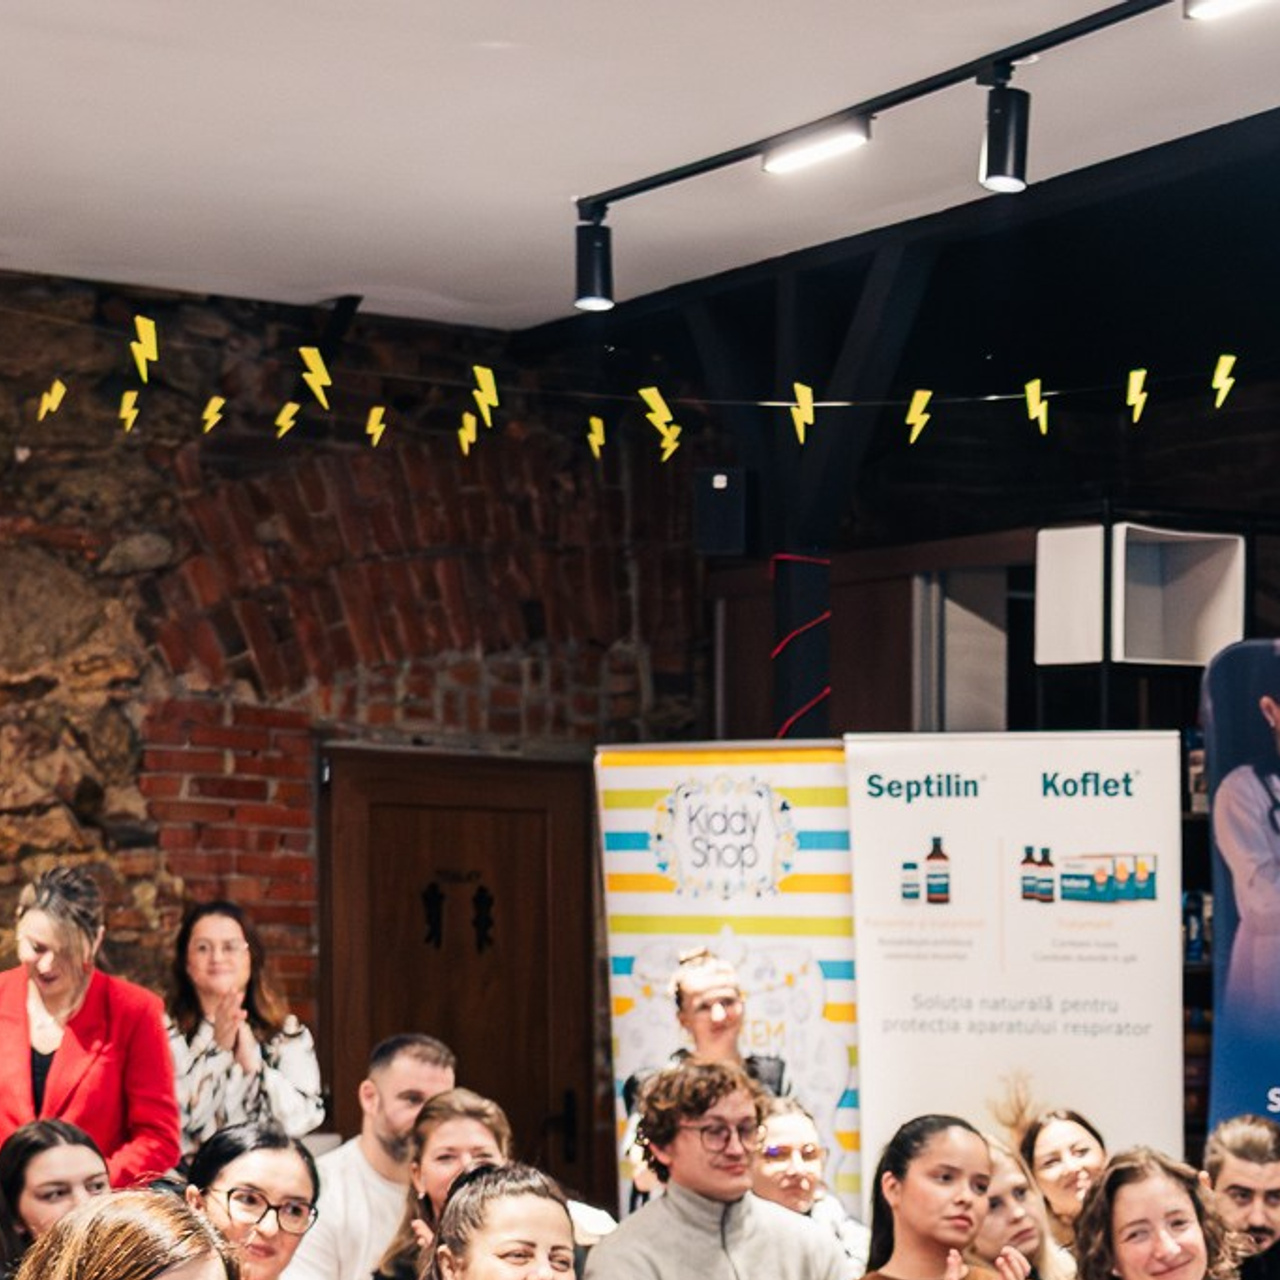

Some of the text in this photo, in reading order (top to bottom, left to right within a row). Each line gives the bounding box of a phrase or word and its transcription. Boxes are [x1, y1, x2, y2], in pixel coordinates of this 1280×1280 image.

[688, 802, 761, 841] Kiddy
[691, 837, 758, 874] Shop
[979, 994, 1053, 1012] naturală
[1061, 997, 1119, 1016] pentru
[967, 1018, 1056, 1037] aparatului
[1063, 1020, 1151, 1037] respirator
